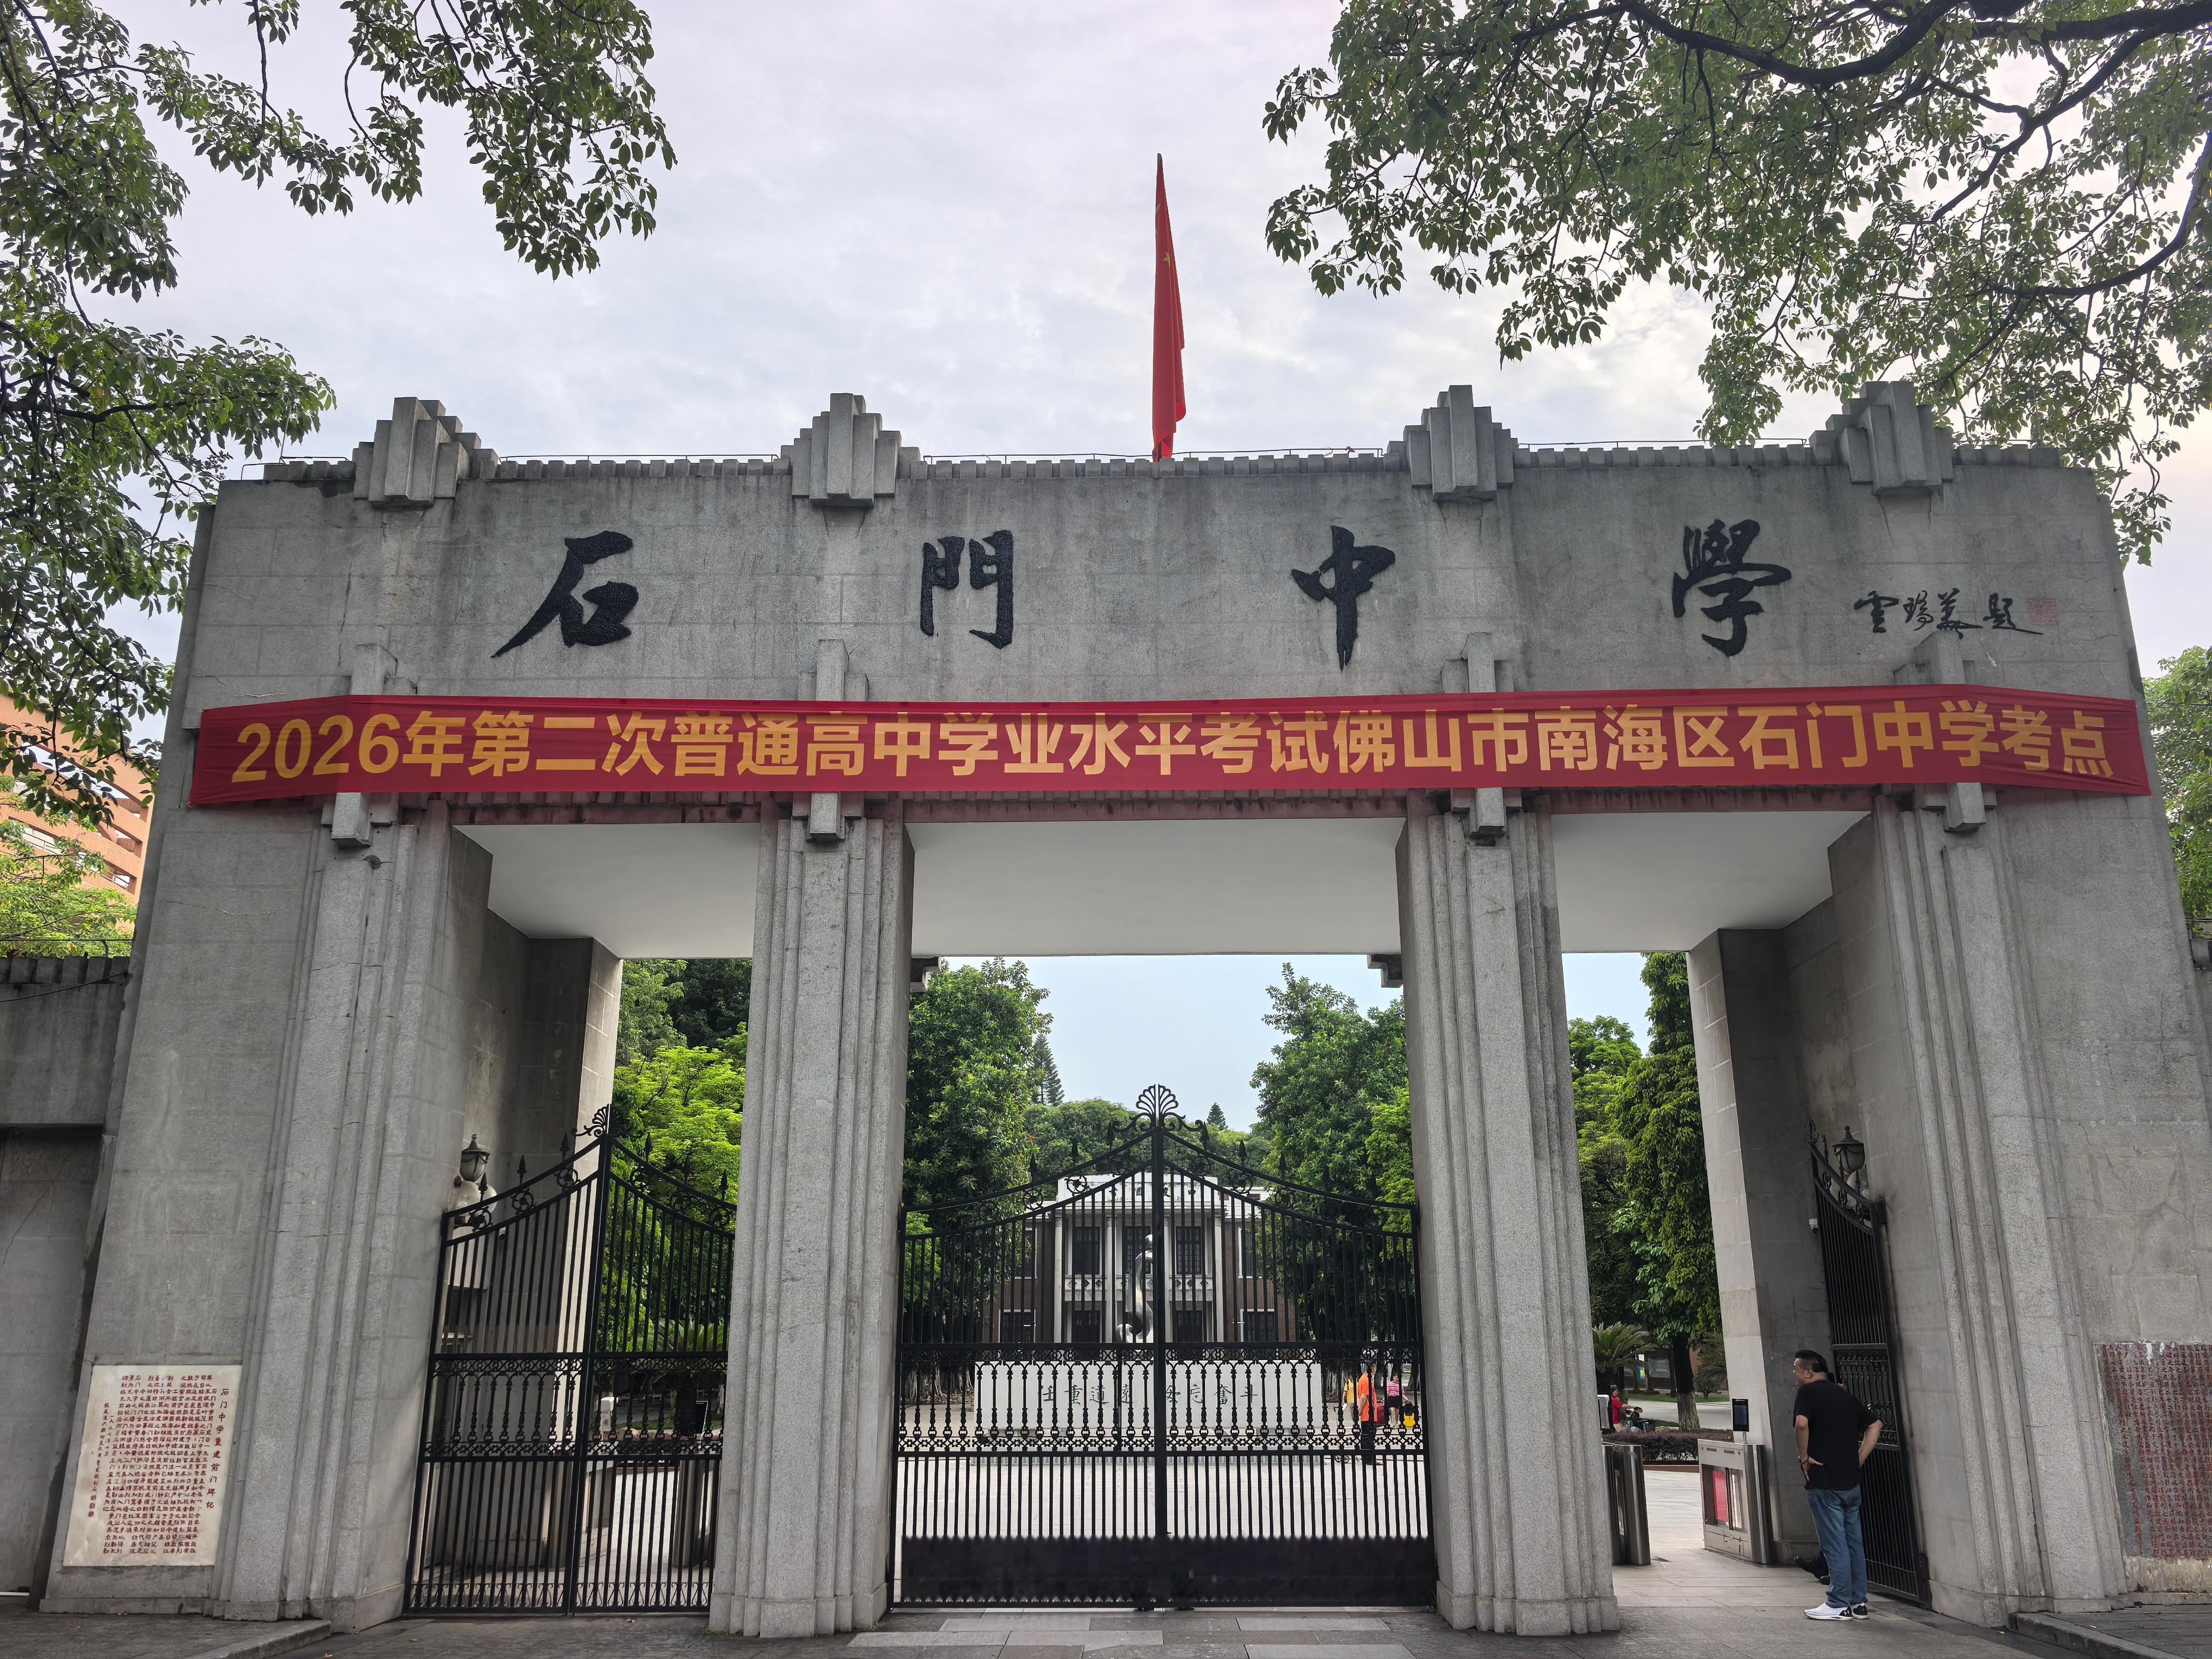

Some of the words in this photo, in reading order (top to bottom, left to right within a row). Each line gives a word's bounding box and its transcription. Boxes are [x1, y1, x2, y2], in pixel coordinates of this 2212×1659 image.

[490, 519, 1792, 672] 石門中學
[233, 702, 2112, 783] 2026年第二次普通高中学业水平考试佛山市南海区石门中学考点
[206, 1388, 229, 1508] 石门中学重建前门碑记
